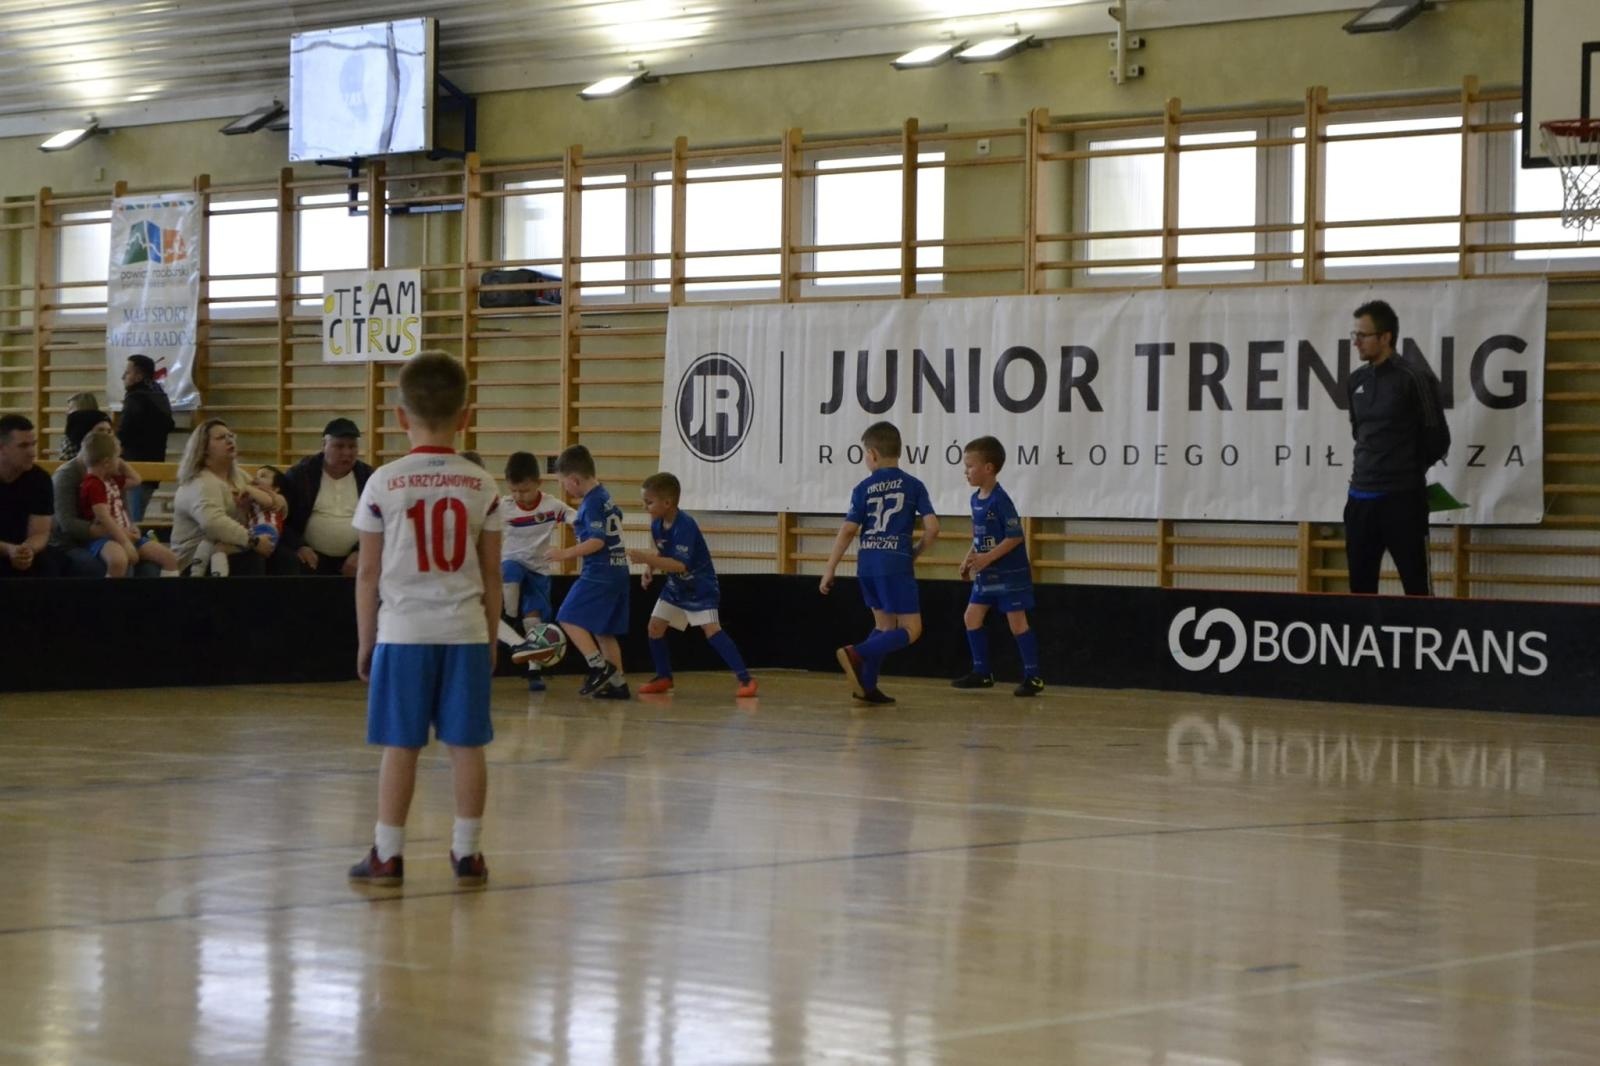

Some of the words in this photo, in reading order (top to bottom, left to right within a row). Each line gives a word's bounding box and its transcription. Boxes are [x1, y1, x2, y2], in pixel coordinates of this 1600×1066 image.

[152, 304, 188, 322] SPORT
[334, 281, 415, 316] TEAM
[329, 317, 420, 356] CITRUS
[820, 345, 1104, 415] JUNIOR
[1135, 334, 1529, 411] TRENNG
[689, 374, 741, 438] JR
[819, 440, 966, 466] ROWÓ
[1017, 444, 1239, 467] MŁODEGO
[1275, 443, 1525, 468] PIŁZA
[388, 476, 406, 491] LKS
[864, 492, 905, 535] 37
[406, 496, 468, 573] 10
[1252, 620, 1549, 677] BONATRANS
